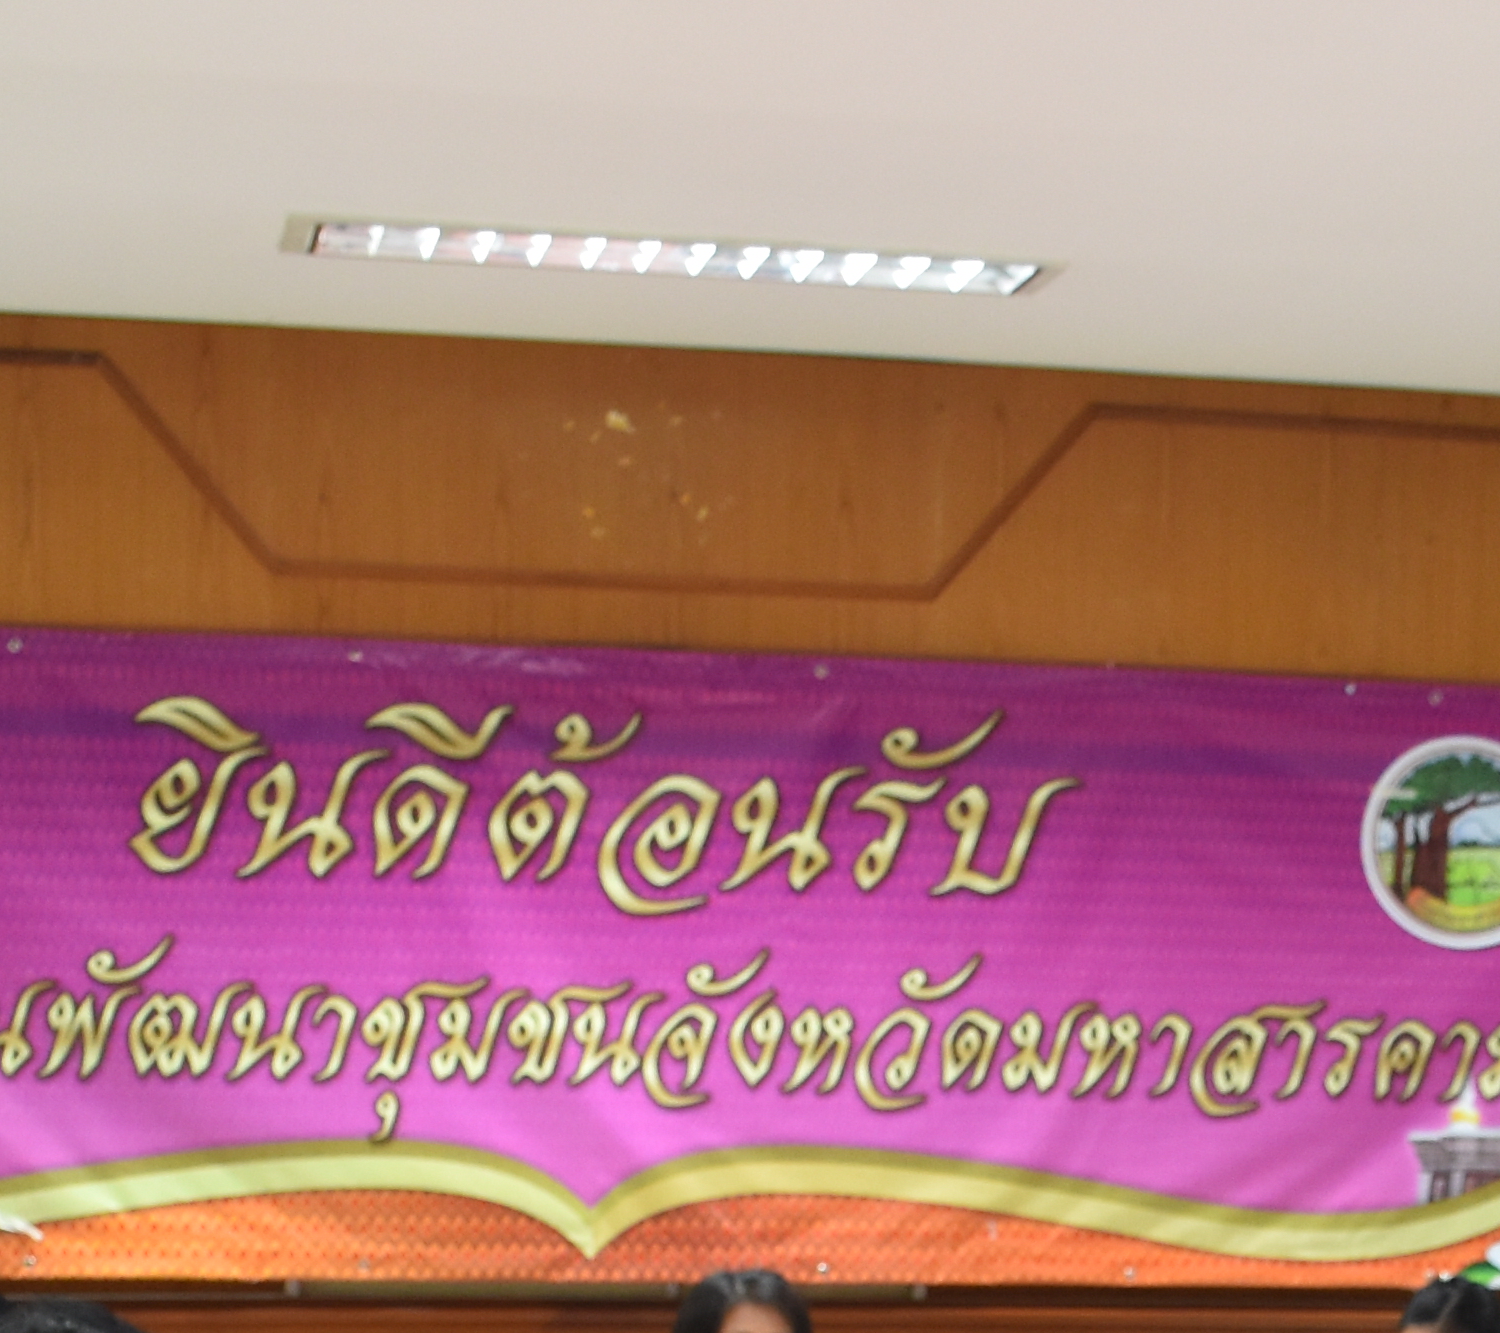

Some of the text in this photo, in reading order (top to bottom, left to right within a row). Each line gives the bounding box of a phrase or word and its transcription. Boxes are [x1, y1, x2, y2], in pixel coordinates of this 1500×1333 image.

[130, 692, 1084, 916] ยินดีต้อนรับ
